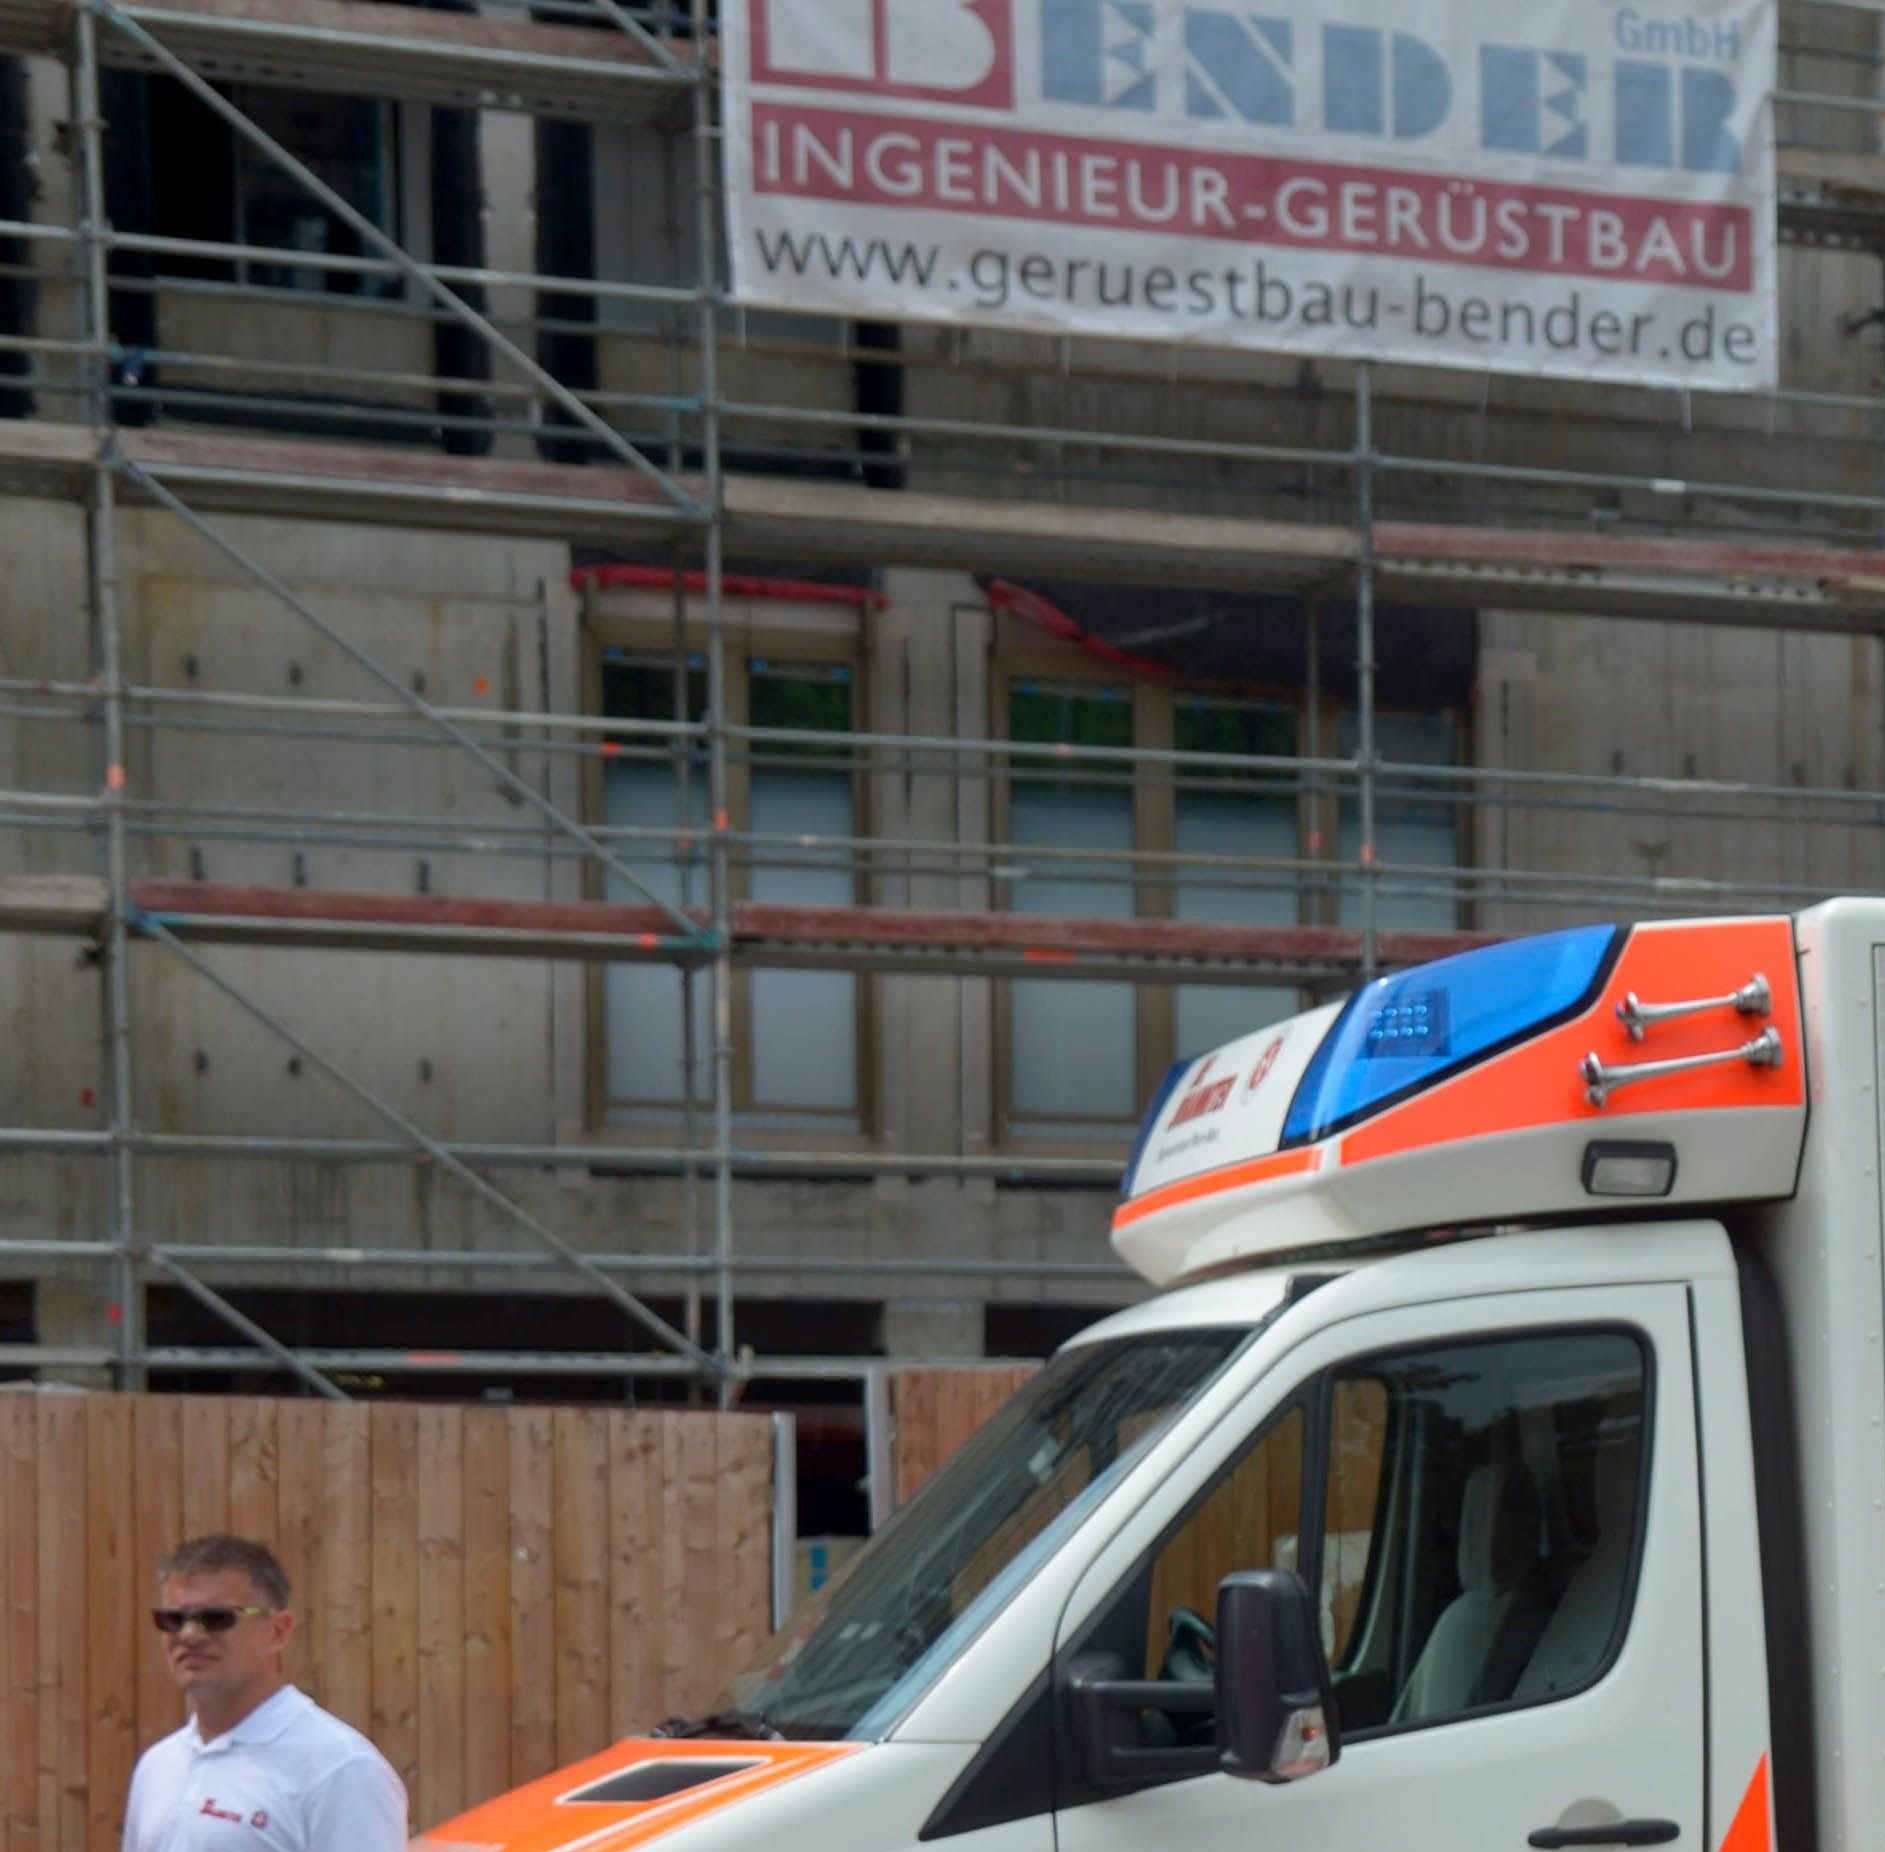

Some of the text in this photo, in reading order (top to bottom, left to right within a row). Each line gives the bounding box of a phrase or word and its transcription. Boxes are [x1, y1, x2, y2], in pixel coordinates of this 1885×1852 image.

[1613, 6, 1742, 62] GmbH
[763, 117, 1737, 279] INGENIEUR-GERÜSTBAU
[755, 226, 1758, 366] www.geruestbau-bender.de
